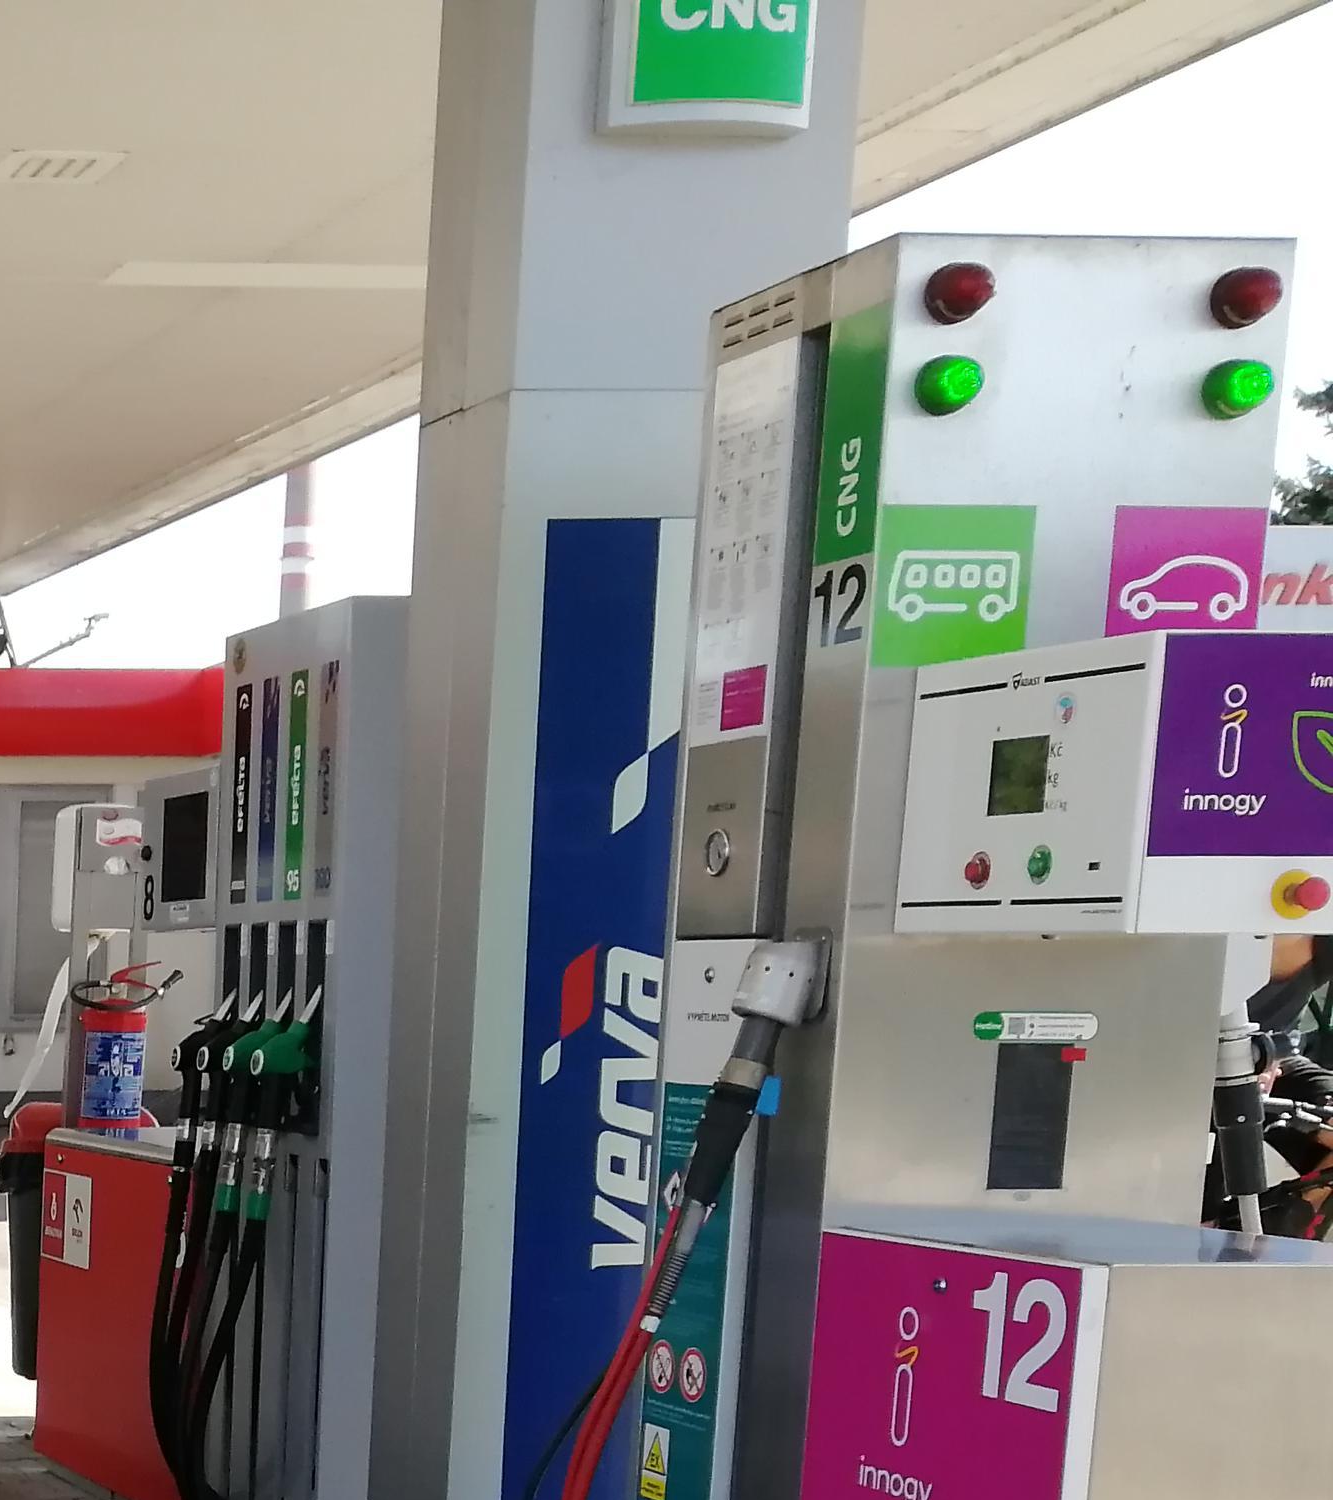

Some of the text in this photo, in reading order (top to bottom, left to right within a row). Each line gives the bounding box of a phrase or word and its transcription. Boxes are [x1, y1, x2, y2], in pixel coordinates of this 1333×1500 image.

[661, 0, 796, 32] CNG
[836, 436, 862, 537] CNG
[814, 563, 867, 648] 12
[1050, 742, 1063, 758] Kč
[1047, 769, 1059, 788] kg
[1182, 788, 1266, 815] innogy
[144, 875, 154, 920] 8
[286, 869, 299, 892] 95
[590, 946, 665, 1270] verva
[973, 1271, 1067, 1413] 12
